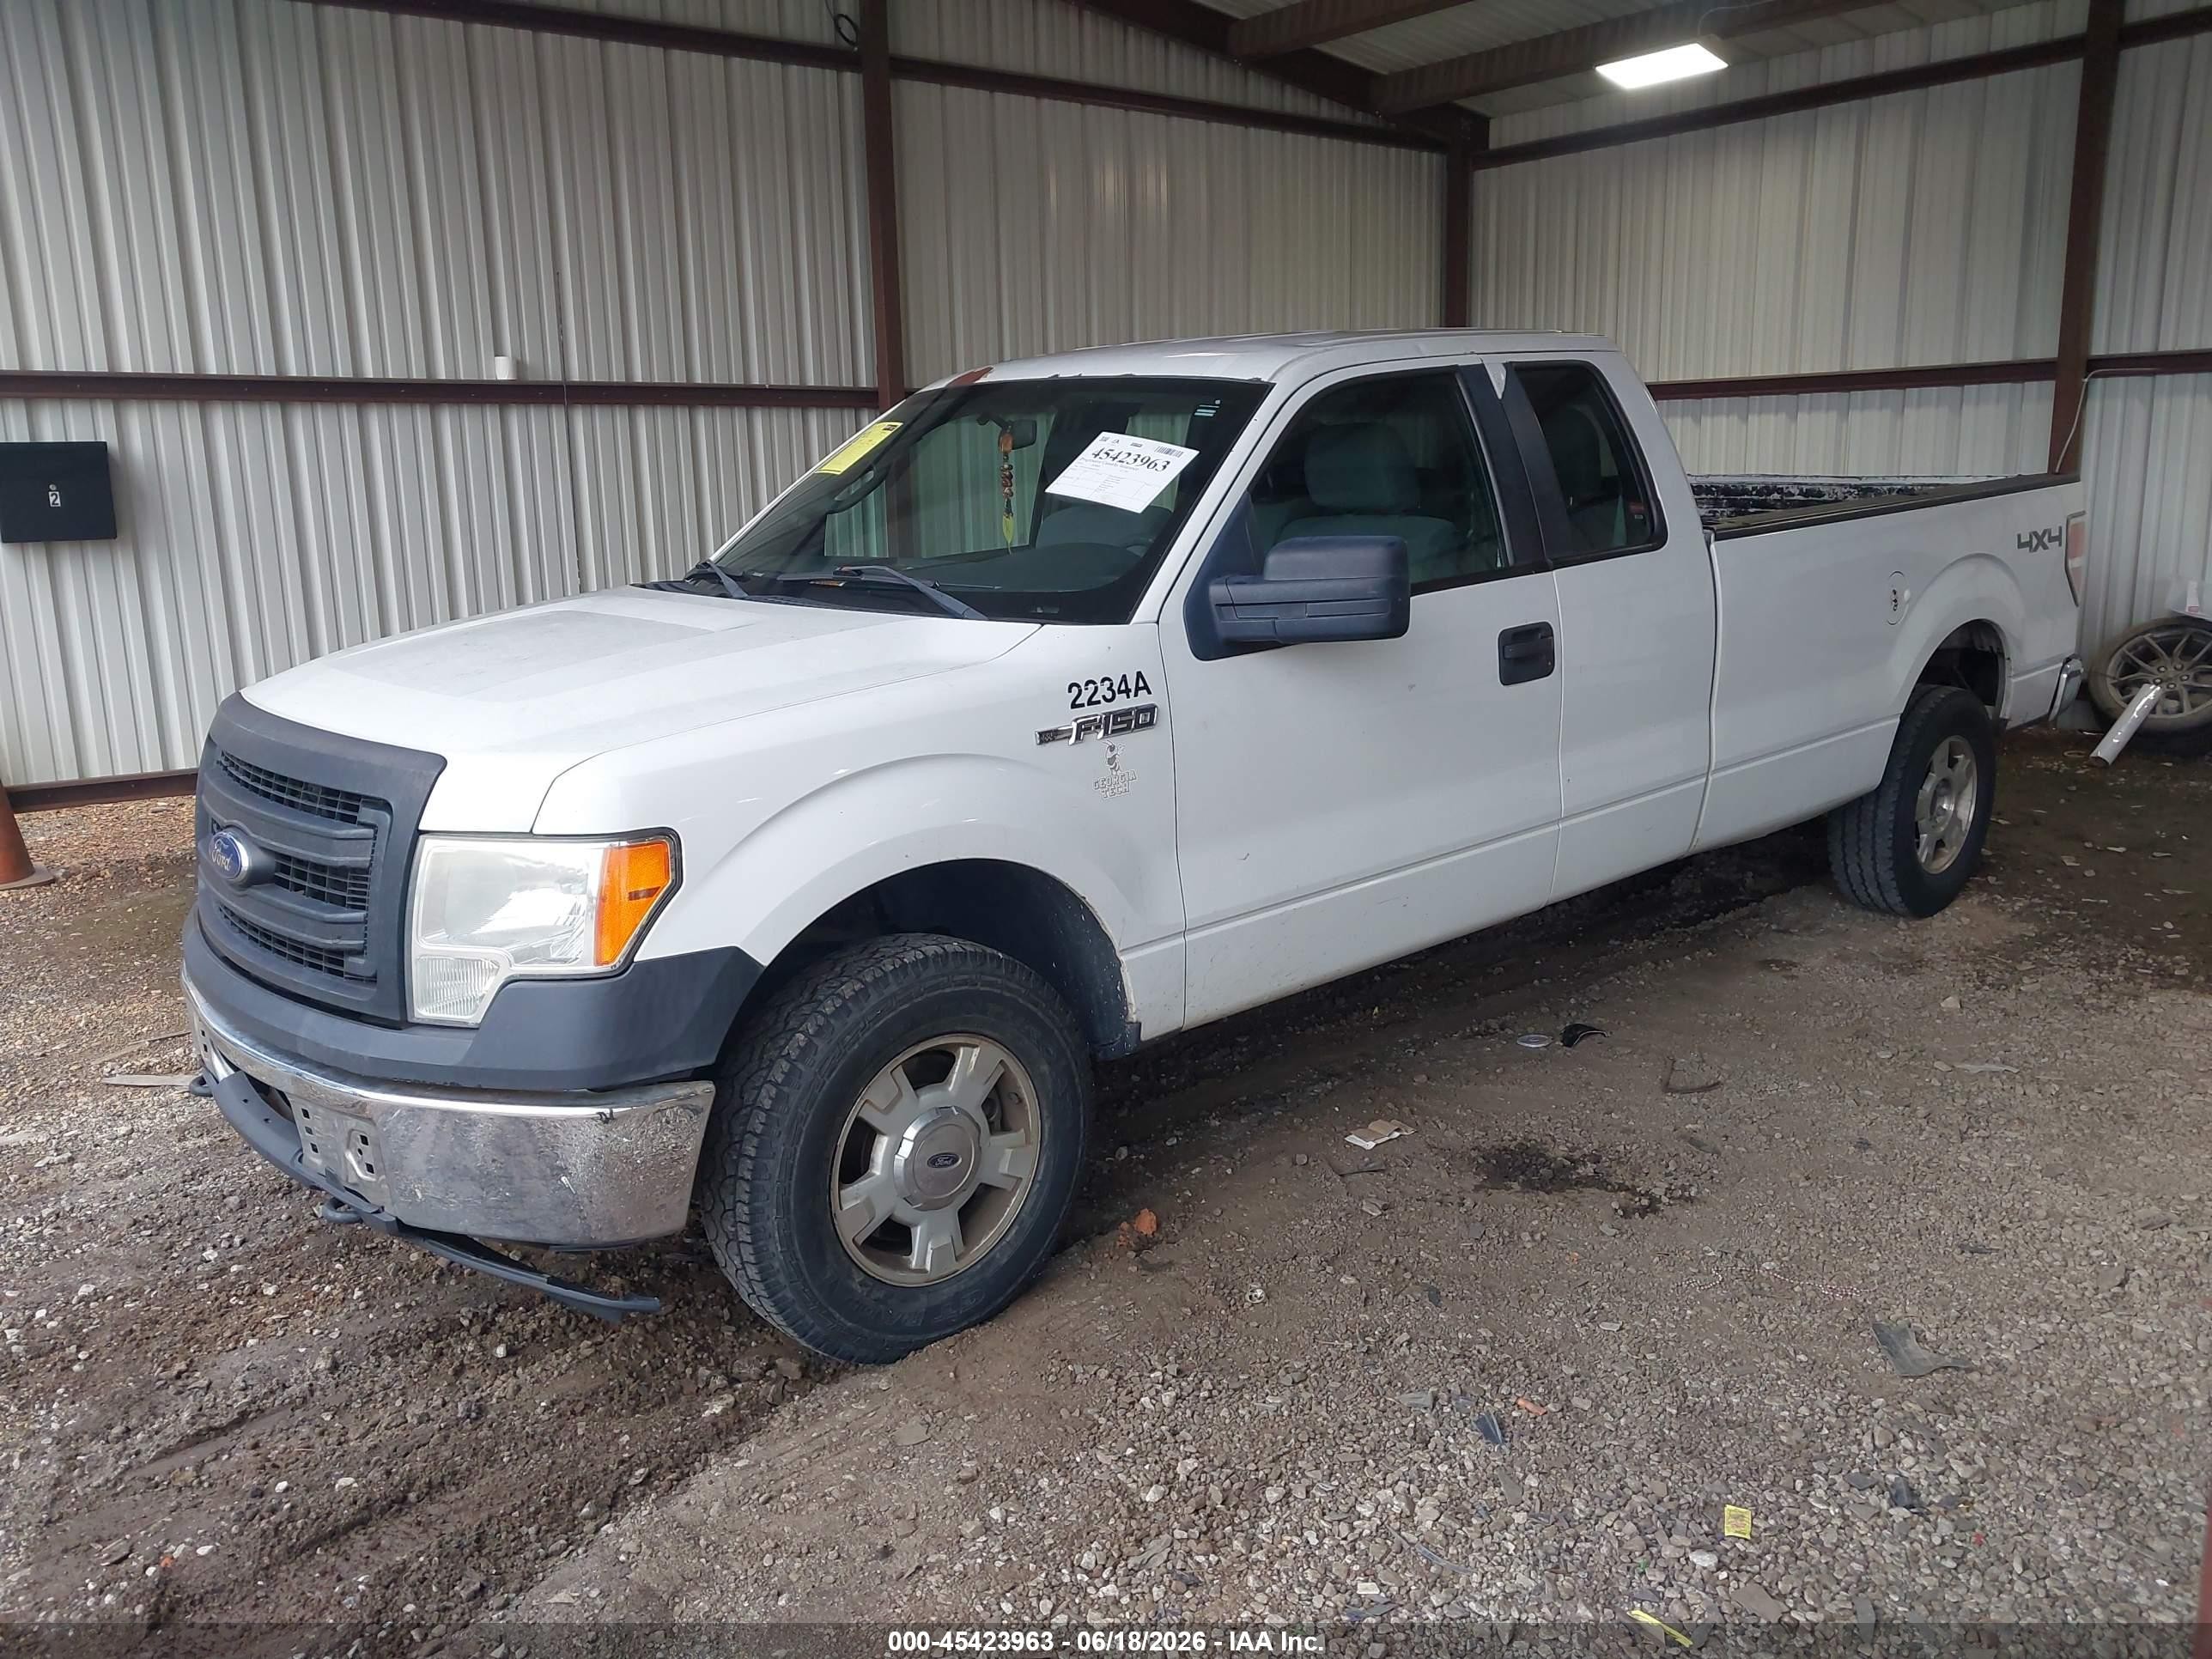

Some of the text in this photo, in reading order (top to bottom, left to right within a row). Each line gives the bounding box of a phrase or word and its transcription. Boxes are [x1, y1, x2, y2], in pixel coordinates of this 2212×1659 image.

[1091, 447, 1171, 472] 45423963
[50, 492, 59, 506] 2
[1067, 671, 1152, 709] 2234A
[1092, 769, 1136, 790] GEORGIA
[1101, 782, 1130, 799] TECH
[210, 837, 235, 872] Ford
